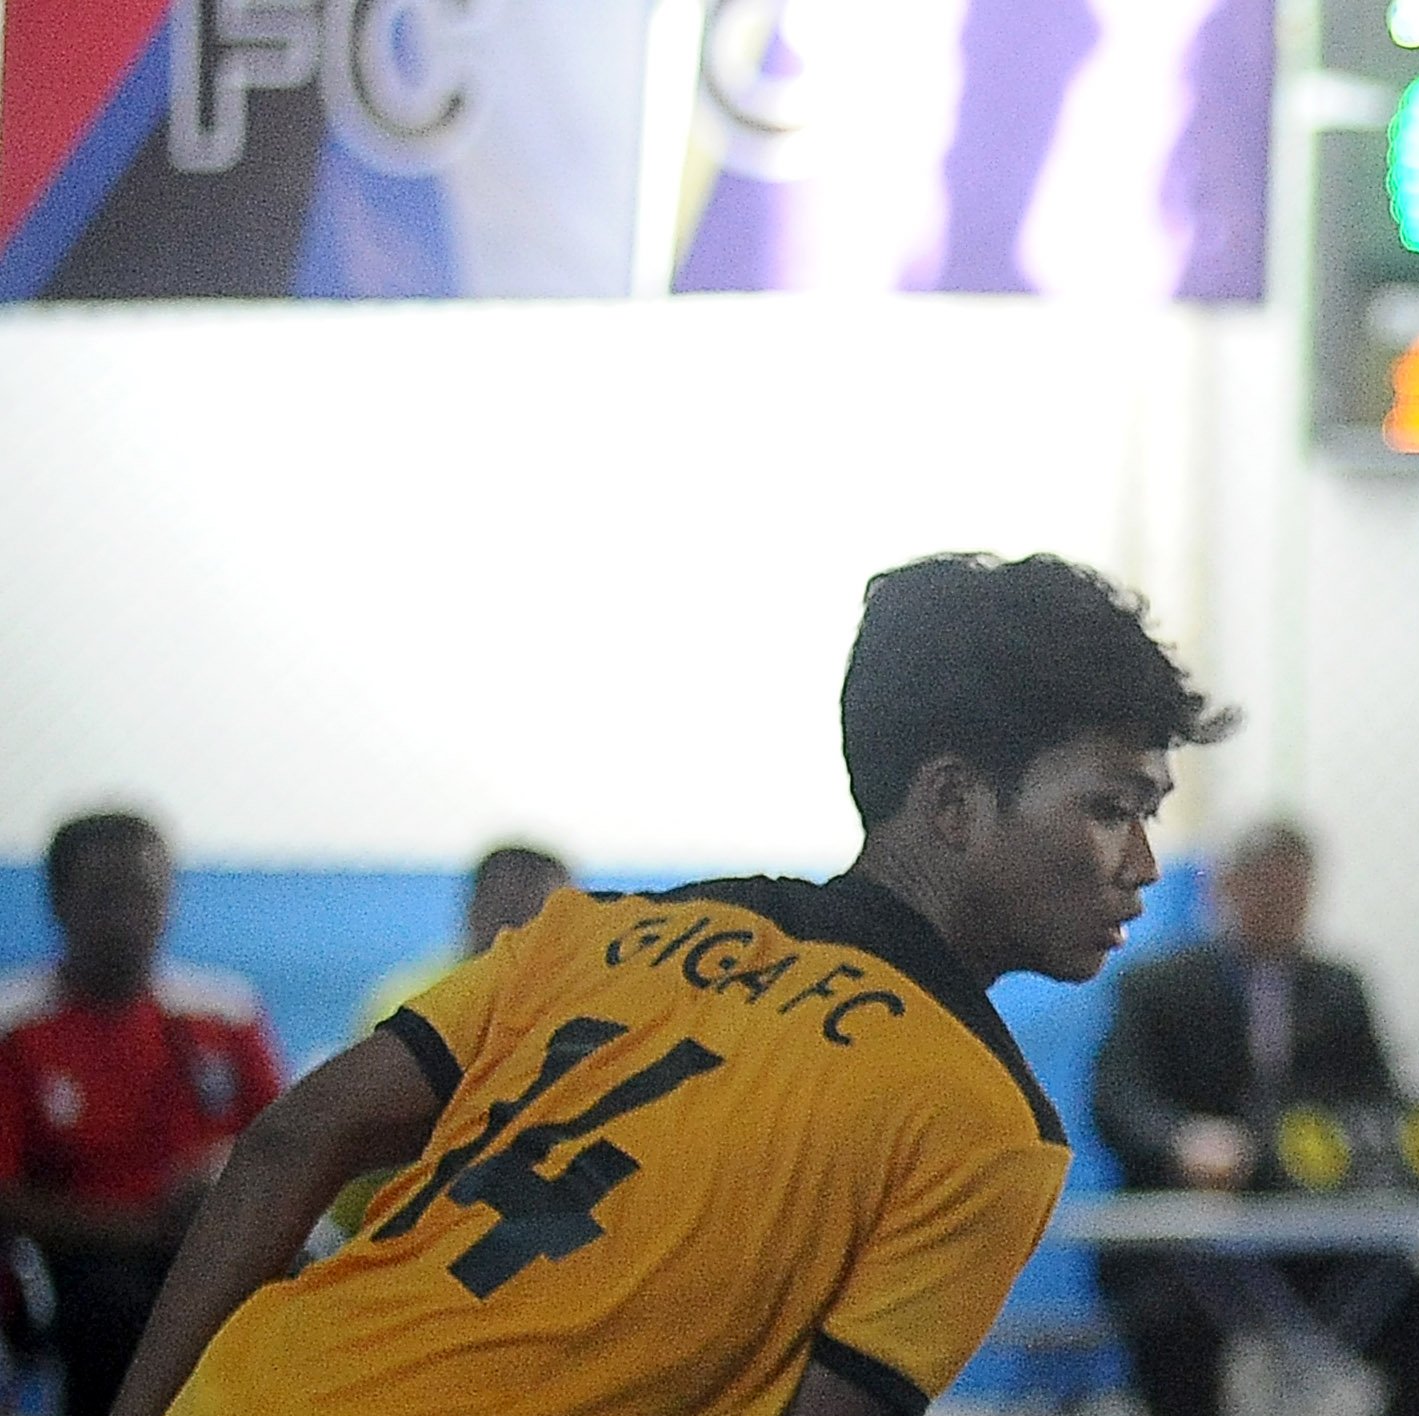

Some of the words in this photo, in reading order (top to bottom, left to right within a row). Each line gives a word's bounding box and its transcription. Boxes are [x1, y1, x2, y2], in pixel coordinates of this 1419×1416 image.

[605, 914, 797, 1005] GIGA
[778, 963, 906, 1047] FC
[368, 1014, 726, 1302] 14
